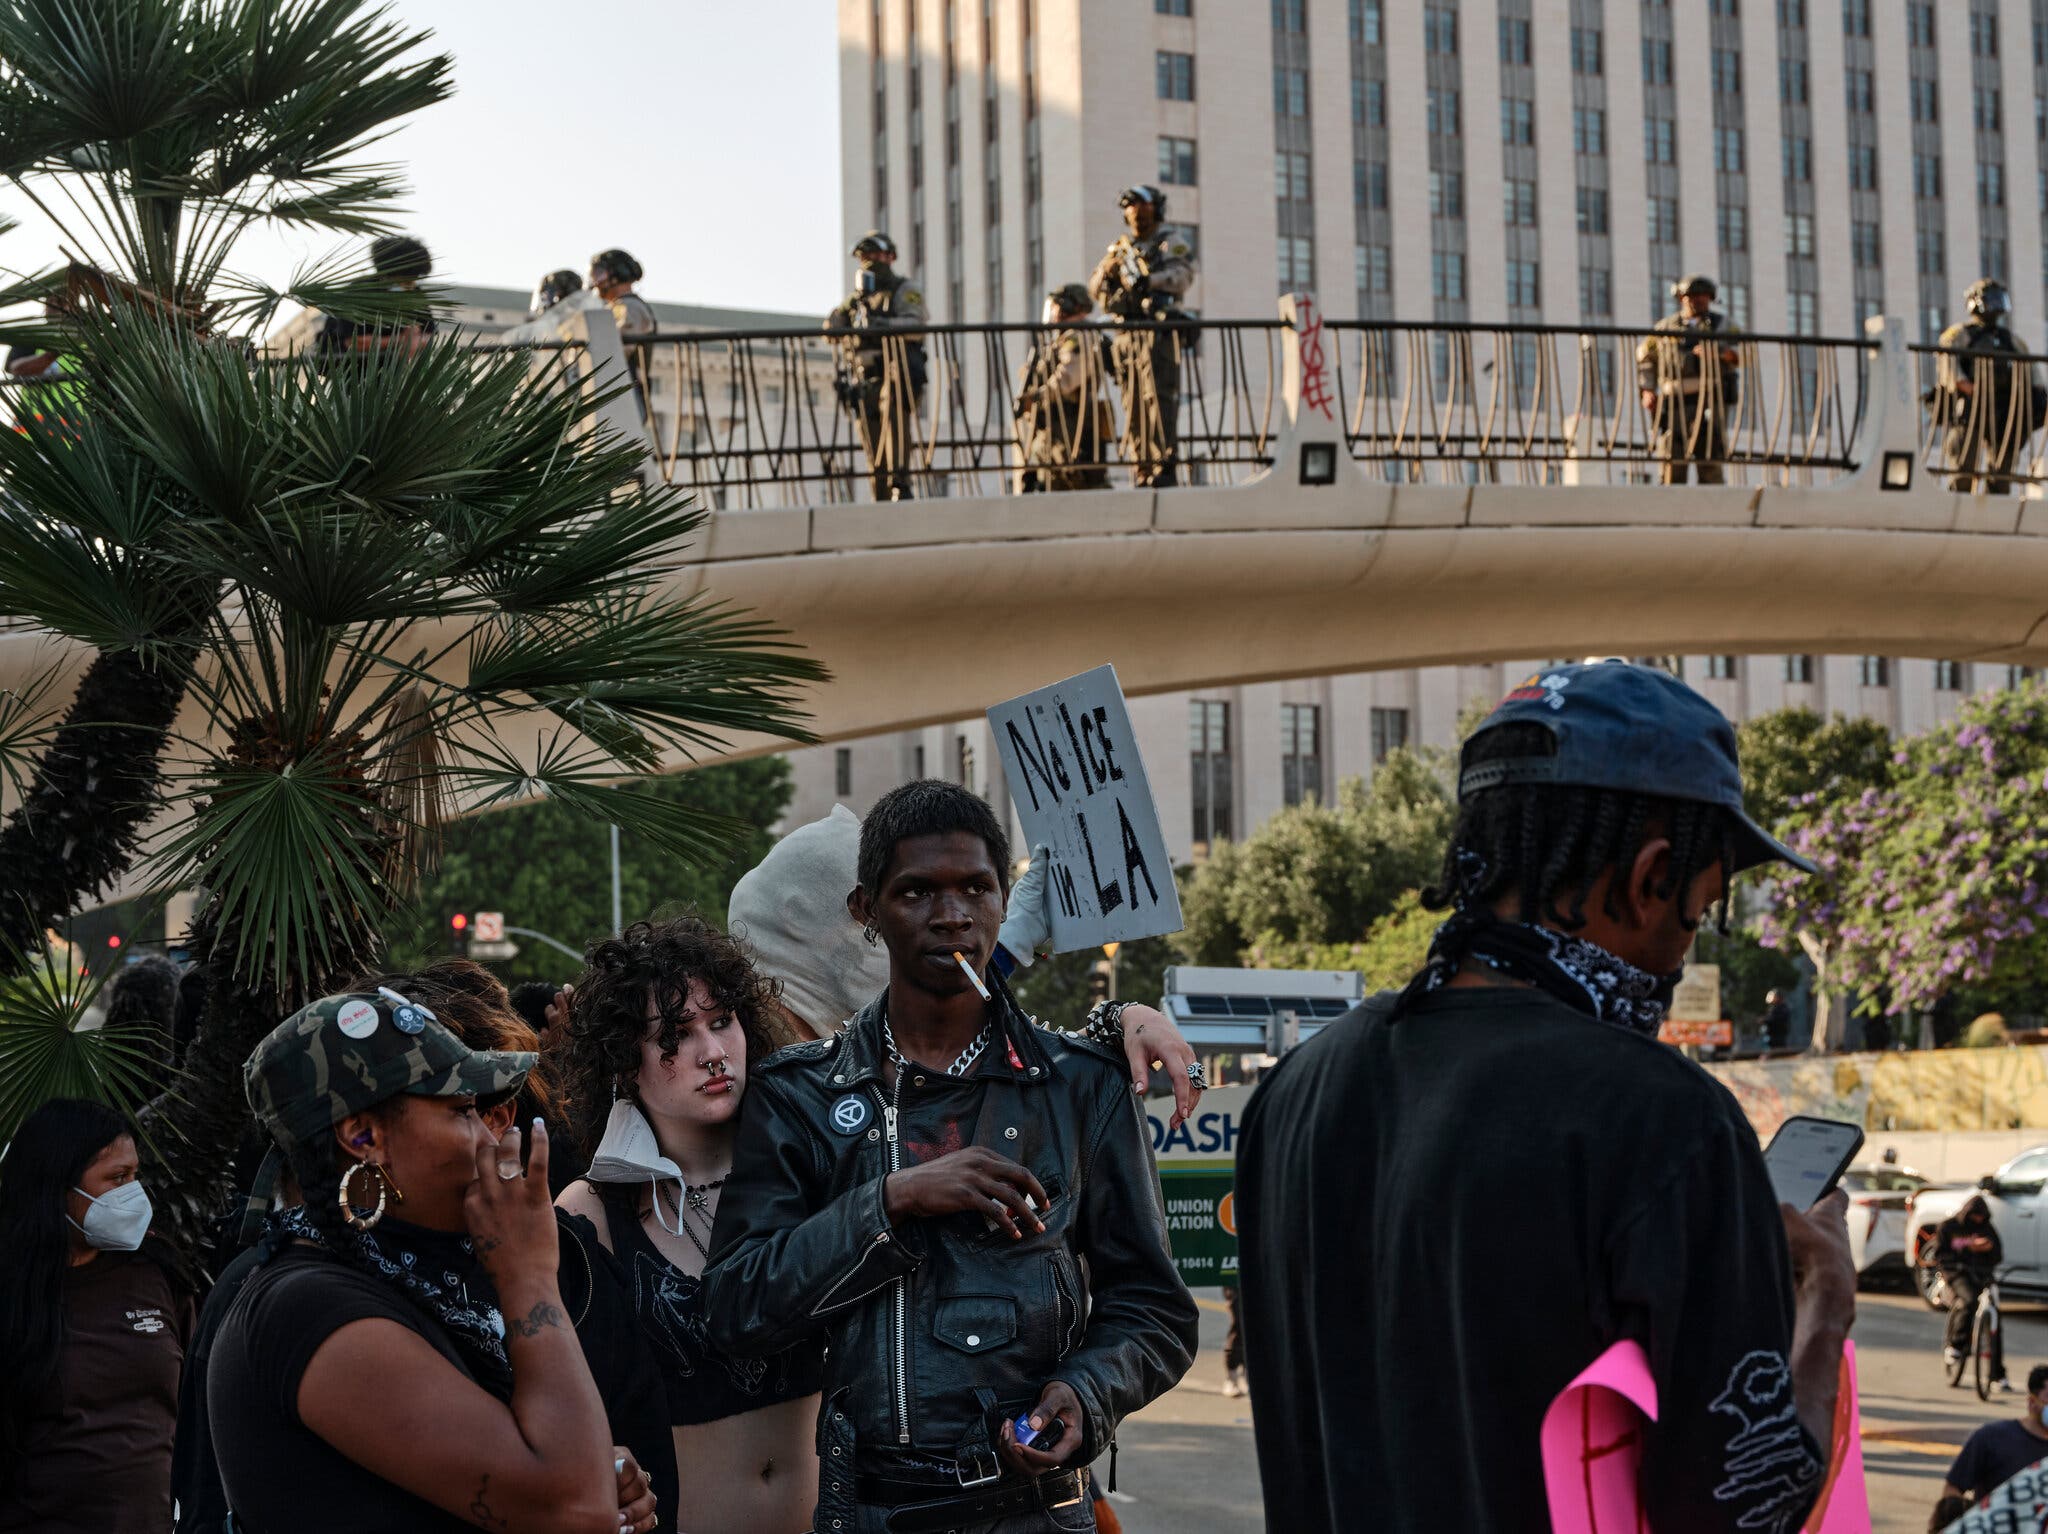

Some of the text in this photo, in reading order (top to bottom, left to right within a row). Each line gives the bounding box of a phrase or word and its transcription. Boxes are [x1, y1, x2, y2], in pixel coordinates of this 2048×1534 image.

[1059, 702, 1124, 797] ICE
[1077, 797, 1158, 918] LA
[1167, 1199, 1214, 1214] UNION
[1165, 1215, 1214, 1230] TATION
[1182, 1257, 1213, 1269] 10414
